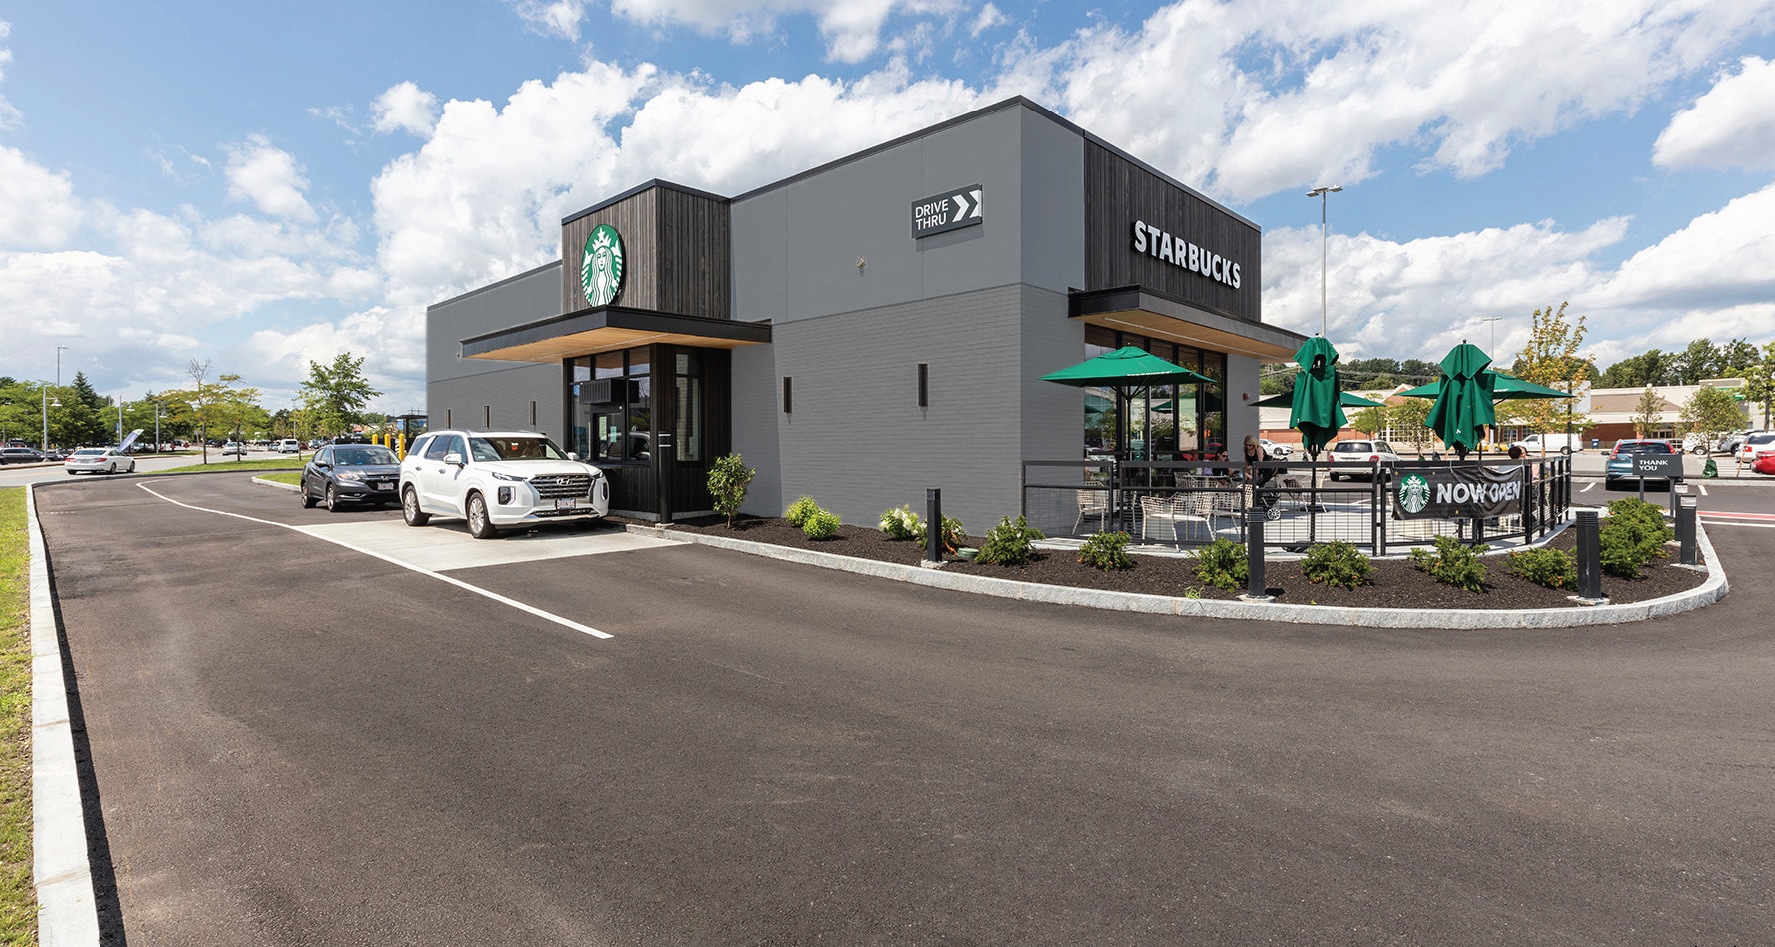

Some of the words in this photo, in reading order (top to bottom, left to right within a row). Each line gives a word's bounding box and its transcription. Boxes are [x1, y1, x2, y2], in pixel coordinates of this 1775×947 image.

[915, 199, 949, 219] DRIVE
[915, 212, 947, 231] THRU
[1134, 219, 1241, 290] STARBUCKS
[1436, 482, 1488, 504] NOW
[1489, 480, 1521, 503] OPEN
